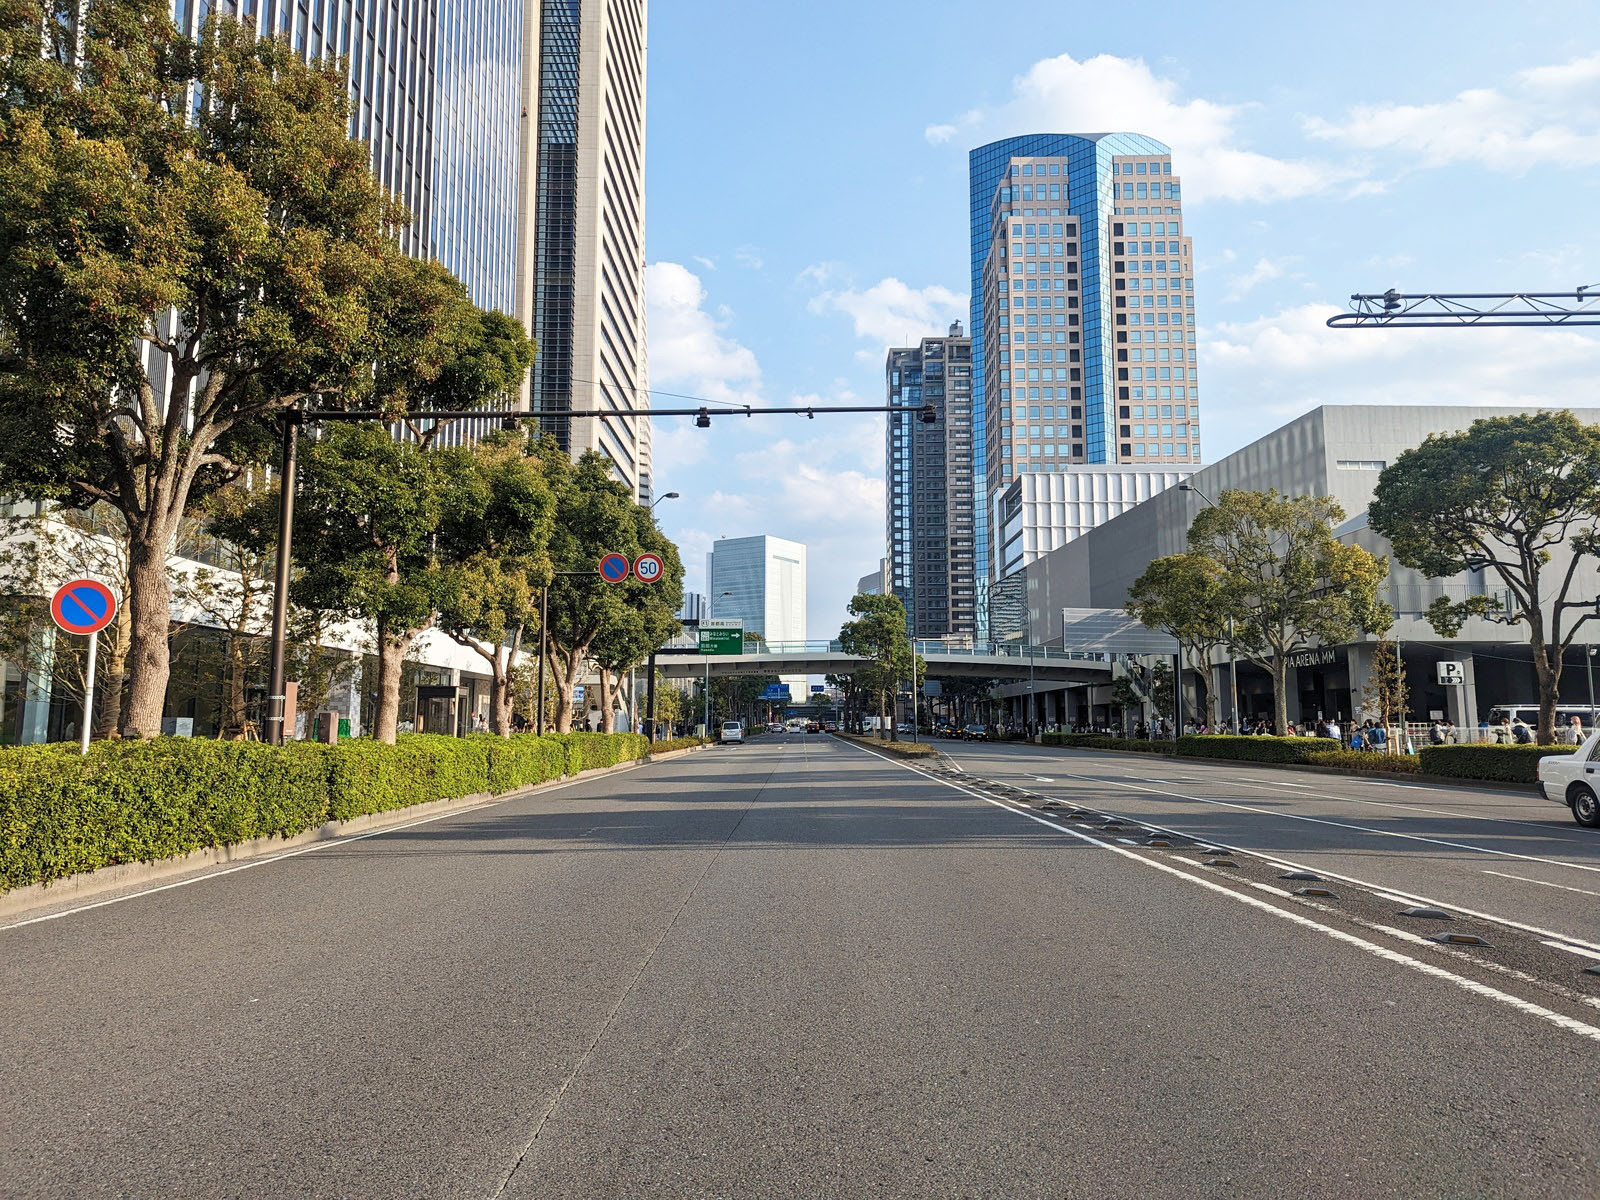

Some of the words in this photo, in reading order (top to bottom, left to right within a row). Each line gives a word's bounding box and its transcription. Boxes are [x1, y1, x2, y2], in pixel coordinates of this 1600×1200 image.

[640, 561, 657, 575] 50
[1295, 652, 1320, 668] ARENA
[1321, 650, 1336, 664] MM
[1446, 663, 1456, 676] P
